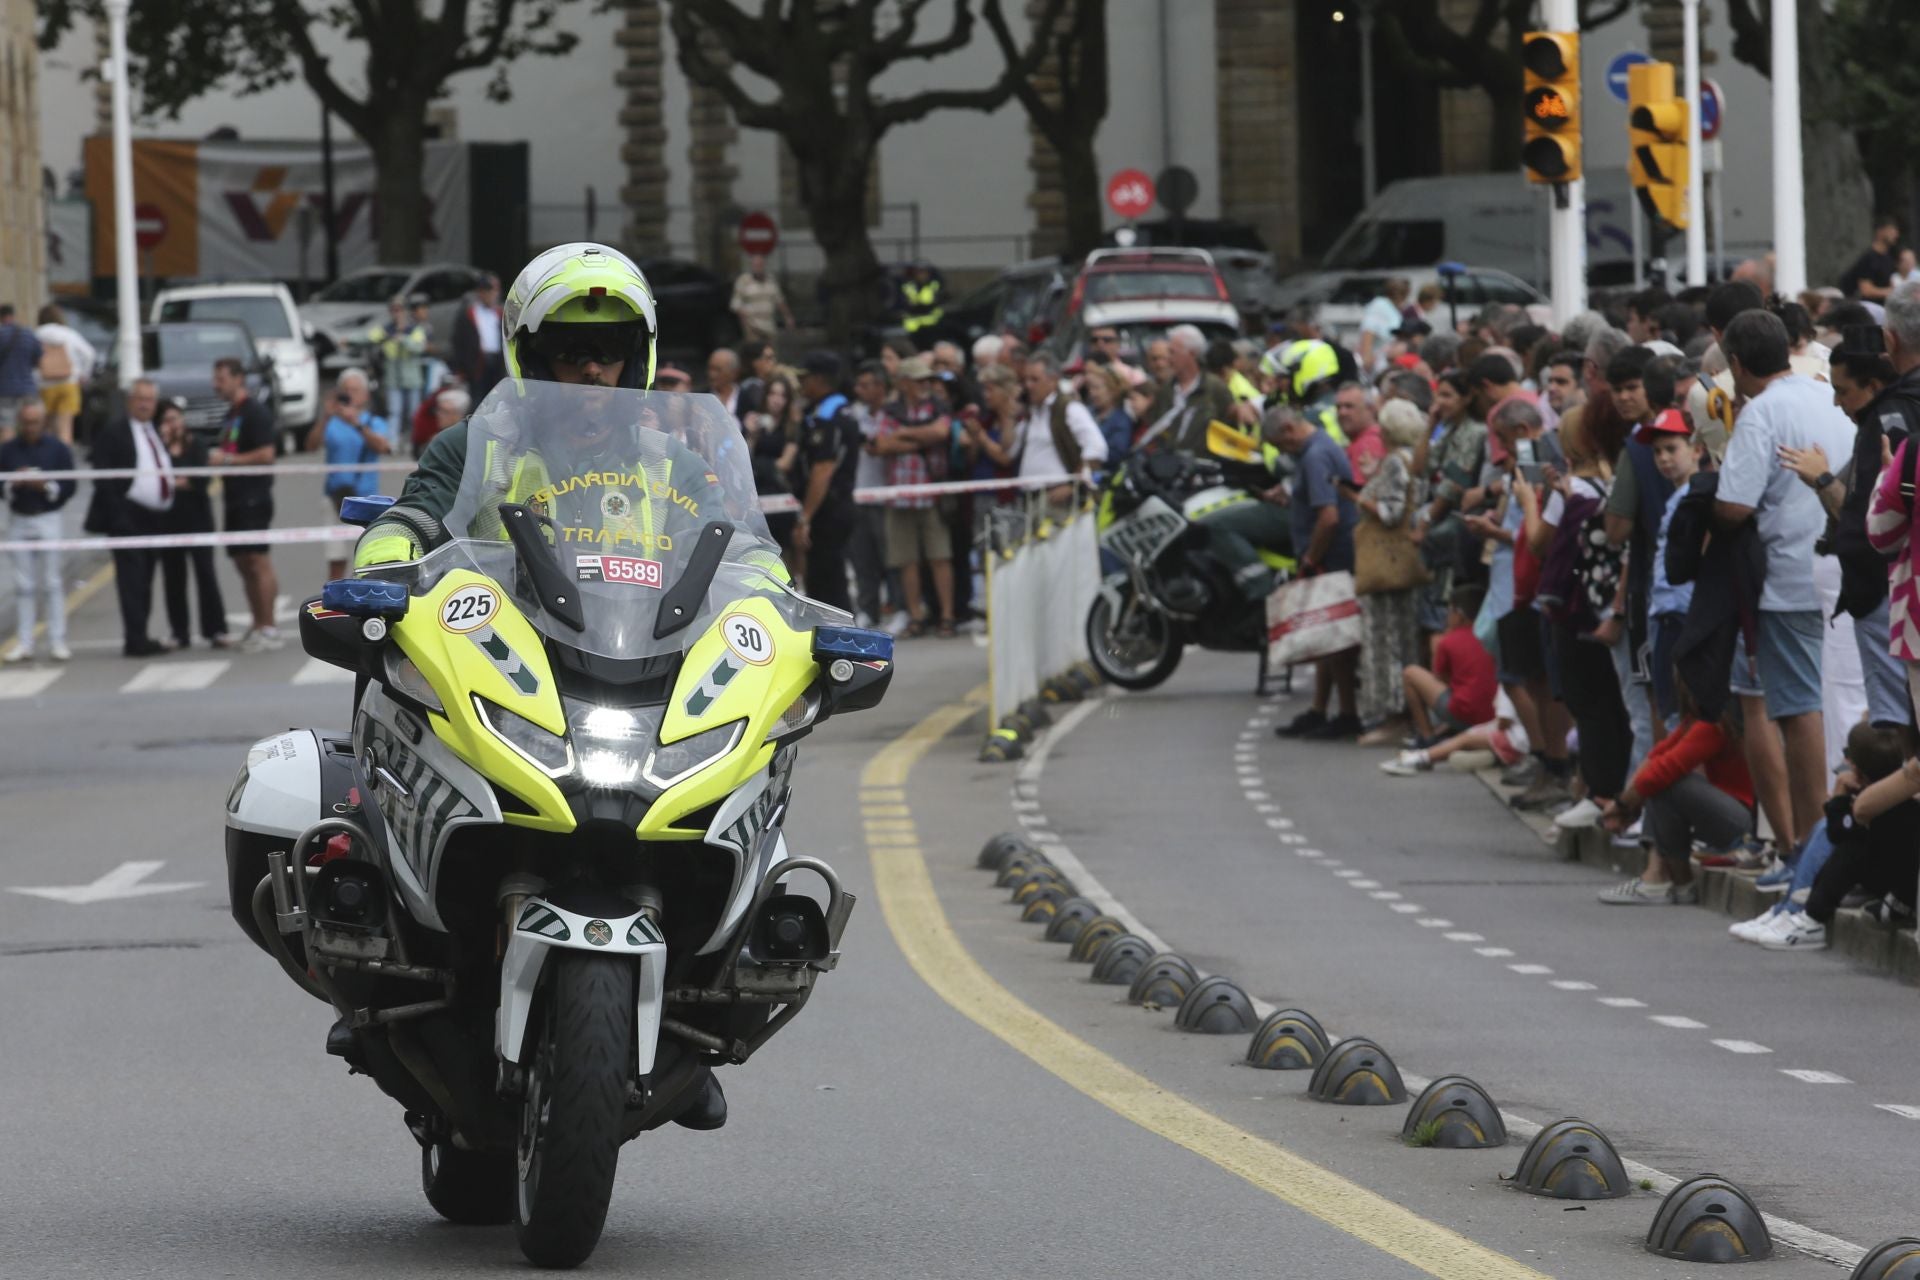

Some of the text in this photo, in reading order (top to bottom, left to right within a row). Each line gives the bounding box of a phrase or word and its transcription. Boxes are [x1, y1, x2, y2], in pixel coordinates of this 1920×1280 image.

[534, 472, 699, 518] GUARDIA CIVIL
[609, 560, 658, 582] 5589
[446, 594, 491, 623] 225
[735, 623, 762, 652] 30
